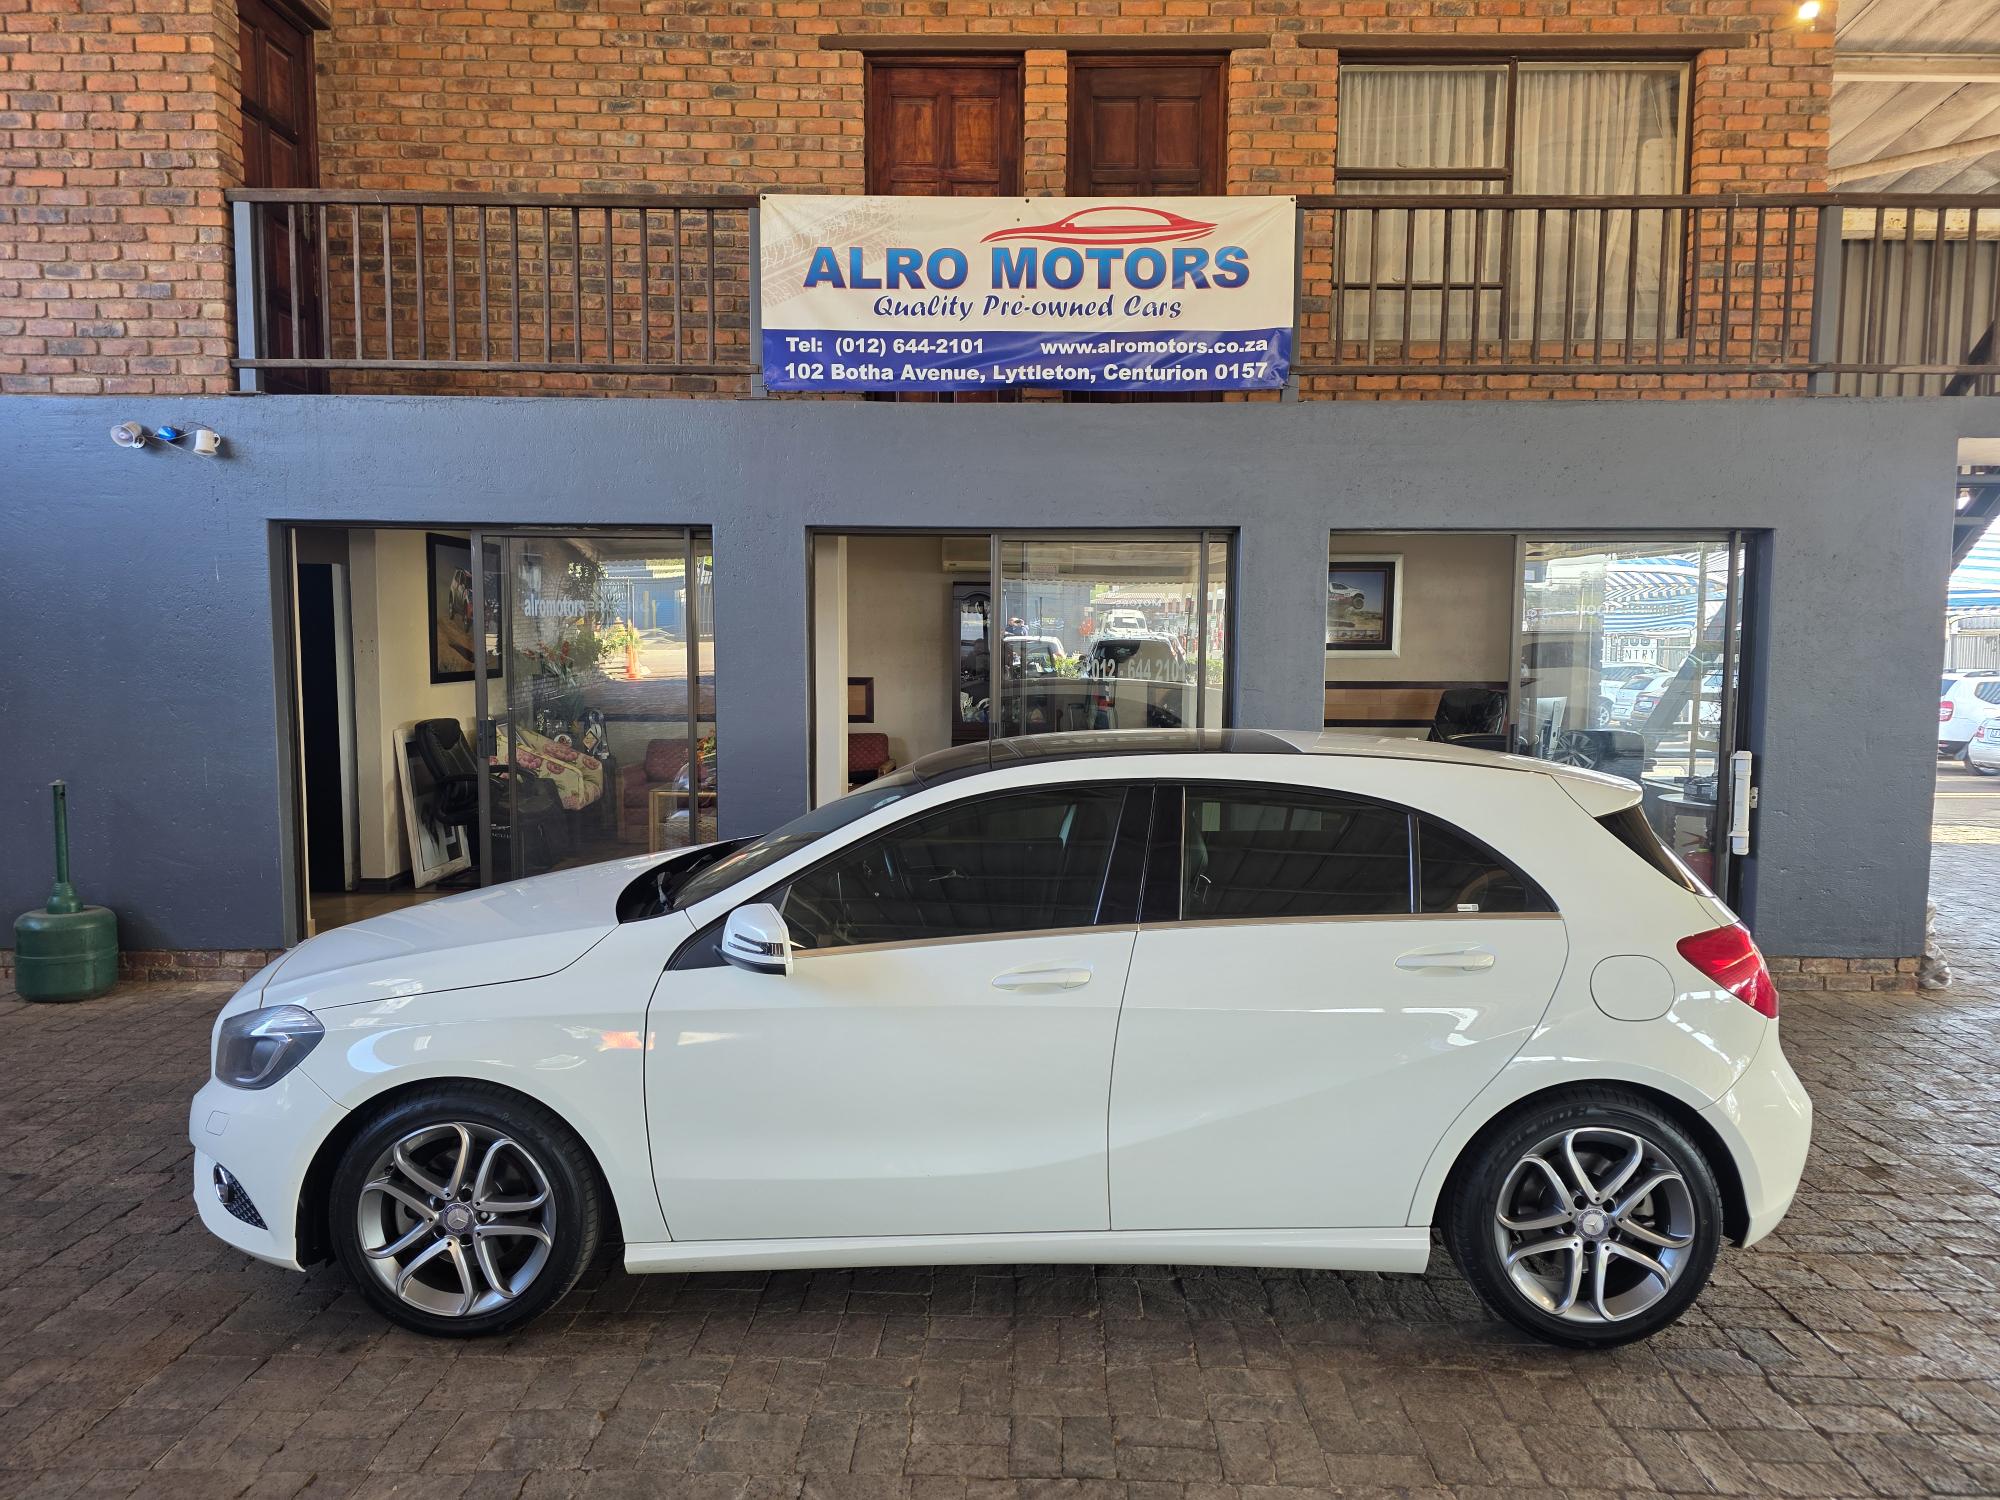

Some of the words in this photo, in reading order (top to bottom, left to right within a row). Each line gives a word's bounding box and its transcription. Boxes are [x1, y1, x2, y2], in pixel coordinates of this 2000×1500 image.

[803, 246, 968, 290] ALRO
[991, 245, 1250, 290] MOTORS
[873, 295, 974, 321] Quality
[983, 294, 1115, 318] Pre-owned
[1123, 295, 1182, 319] Cars
[786, 337, 823, 353] Tel:
[835, 338, 887, 357] (012)
[893, 338, 984, 354] 644-2101
[1040, 338, 1268, 355] www.alromotors.co.za
[785, 363, 824, 380] 102
[831, 364, 894, 381] Botha
[901, 364, 986, 383] Avenue,
[993, 365, 1096, 384] Lyttleton,
[1103, 364, 1208, 381] Centurion
[1214, 362, 1268, 380] 0157
[524, 593, 586, 617] alromotors
[1091, 659, 1116, 681] 012
[1127, 659, 1152, 680] 644
